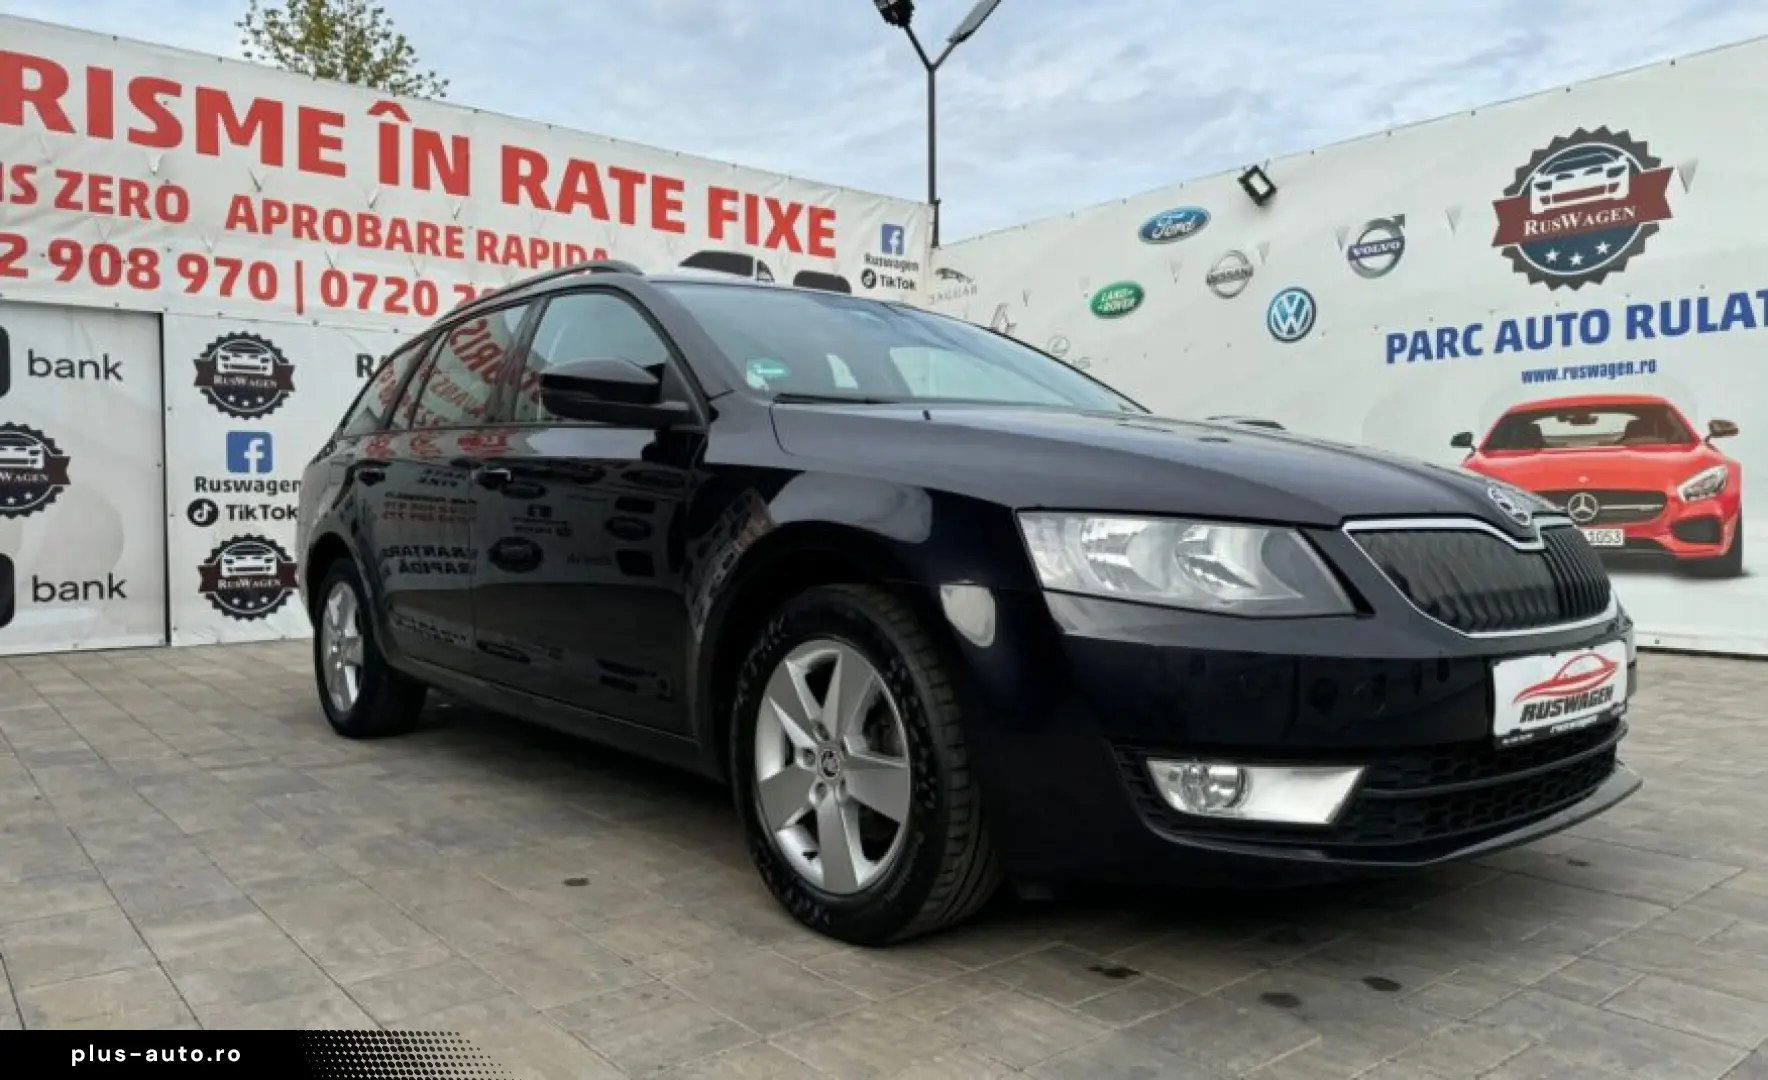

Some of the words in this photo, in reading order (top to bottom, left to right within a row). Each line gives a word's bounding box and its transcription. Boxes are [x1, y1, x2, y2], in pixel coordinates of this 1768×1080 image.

[368, 100, 470, 197] ÎN
[501, 145, 687, 234] RATE
[707, 186, 837, 260] FIXE
[54, 168, 191, 224] ZERO
[225, 194, 465, 260] APROBARE
[1150, 212, 1197, 240] Ford
[864, 252, 919, 272] Ruswagen
[1352, 240, 1401, 257] VOLVO
[47, 239, 161, 290] 908
[177, 253, 278, 302] 970
[320, 269, 439, 317] 0720
[880, 274, 916, 290] TikTok
[1207, 267, 1251, 285] NISSAN
[1386, 323, 1484, 364] PARC
[1493, 309, 1611, 353] AUTO
[28, 349, 123, 381] bank
[1521, 359, 1656, 385] www.ruswagen.ro
[225, 503, 298, 521] TikTok
[32, 573, 128, 603] bank
[1518, 684, 1614, 723] RUSWAGEN
